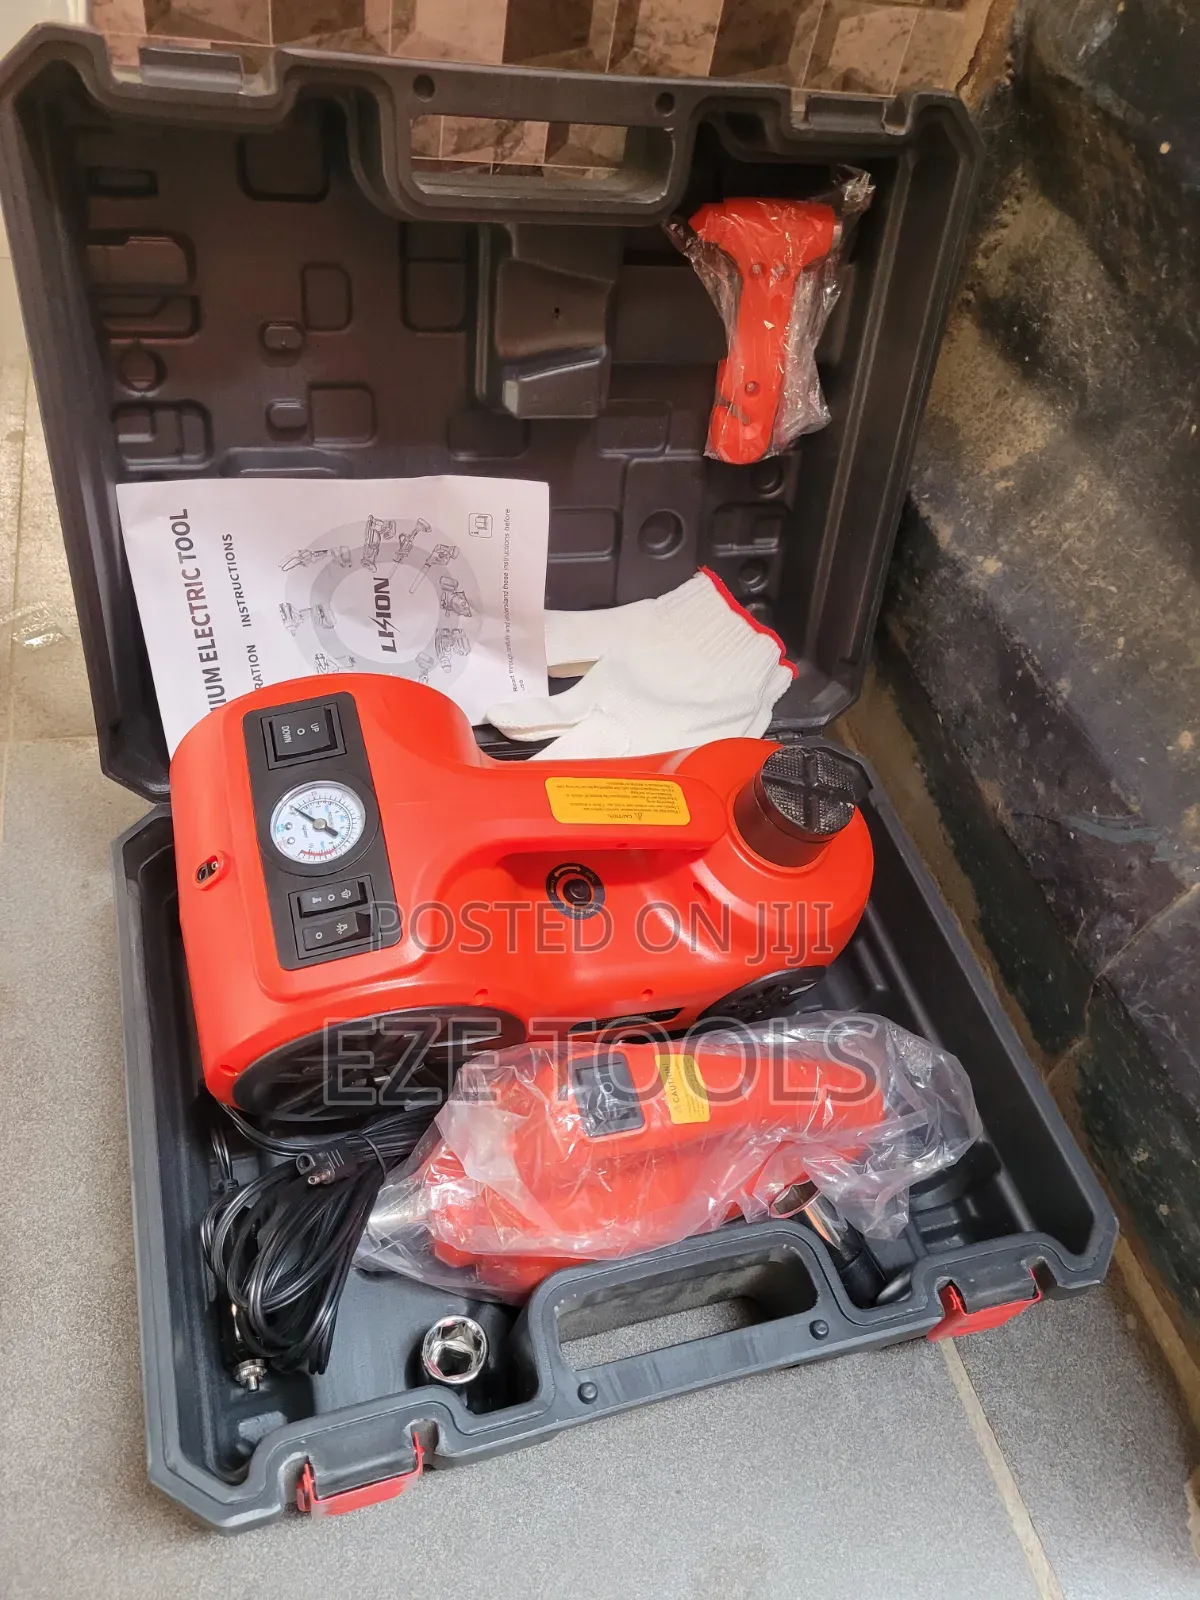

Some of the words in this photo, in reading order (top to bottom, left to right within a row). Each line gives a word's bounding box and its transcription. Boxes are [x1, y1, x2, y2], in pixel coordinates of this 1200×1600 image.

[169, 508, 197, 565] TOOL
[503, 508, 511, 531] before
[222, 533, 252, 628] INSTRUCTIONS
[181, 567, 218, 663] ELECTRIC
[281, 725, 293, 743] DOWN
[310, 722, 320, 733] UP
[662, 1063, 679, 1103] CAUTION!
